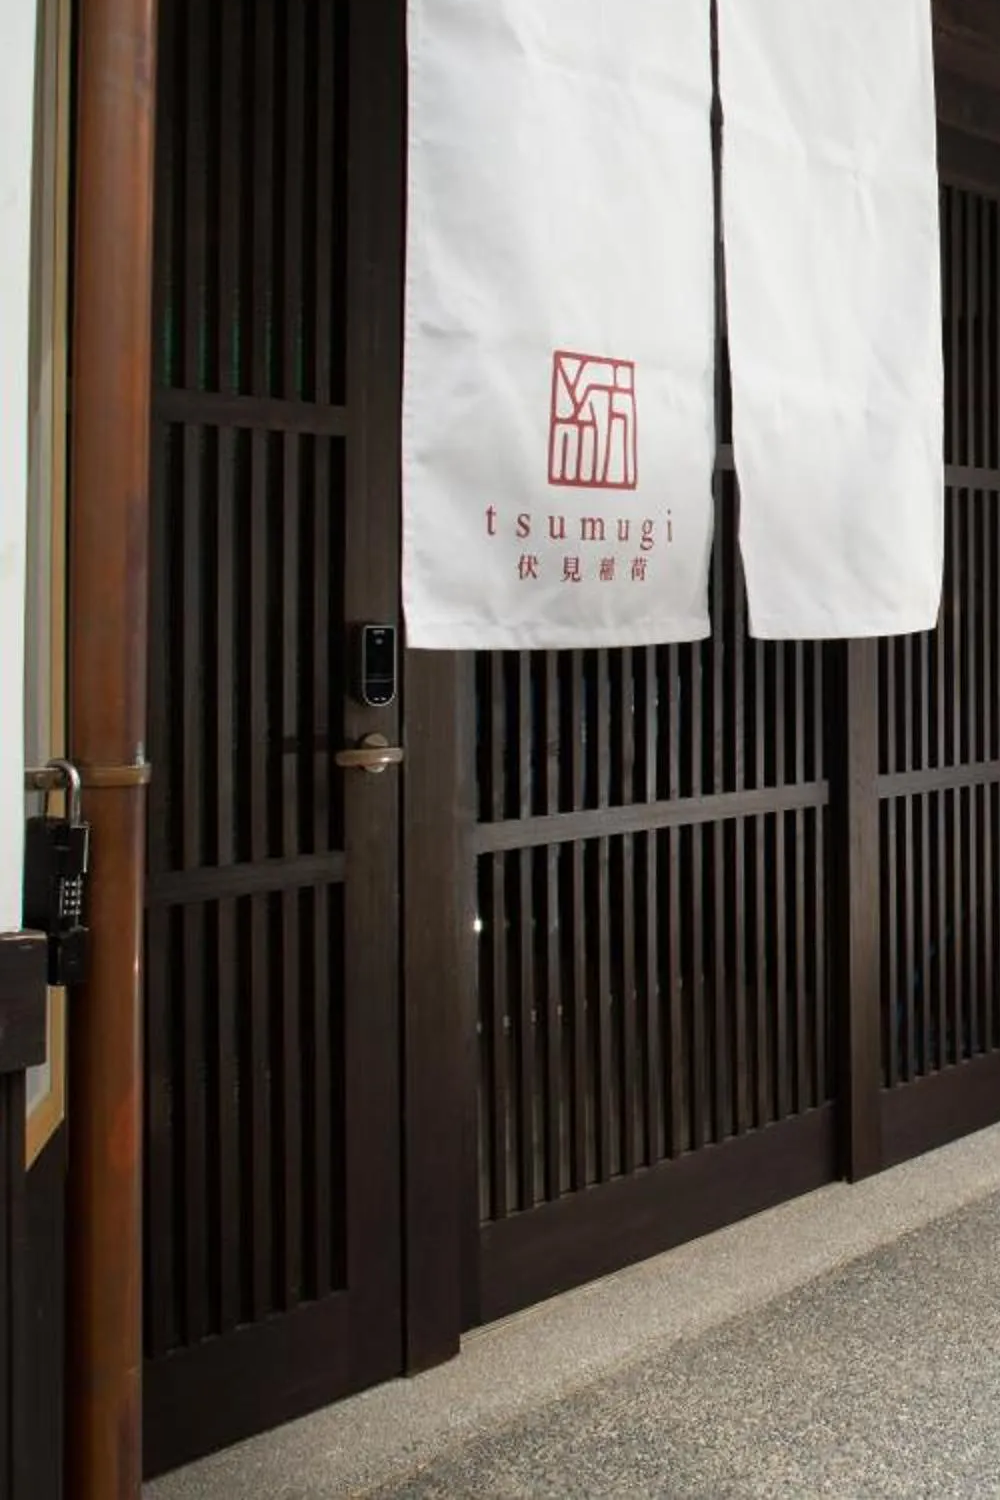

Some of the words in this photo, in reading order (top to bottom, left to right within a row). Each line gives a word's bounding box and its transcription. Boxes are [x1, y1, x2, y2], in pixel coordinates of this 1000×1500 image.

[485, 504, 673, 551] tsumugi
[517, 554, 648, 583] 伏見稲荷
